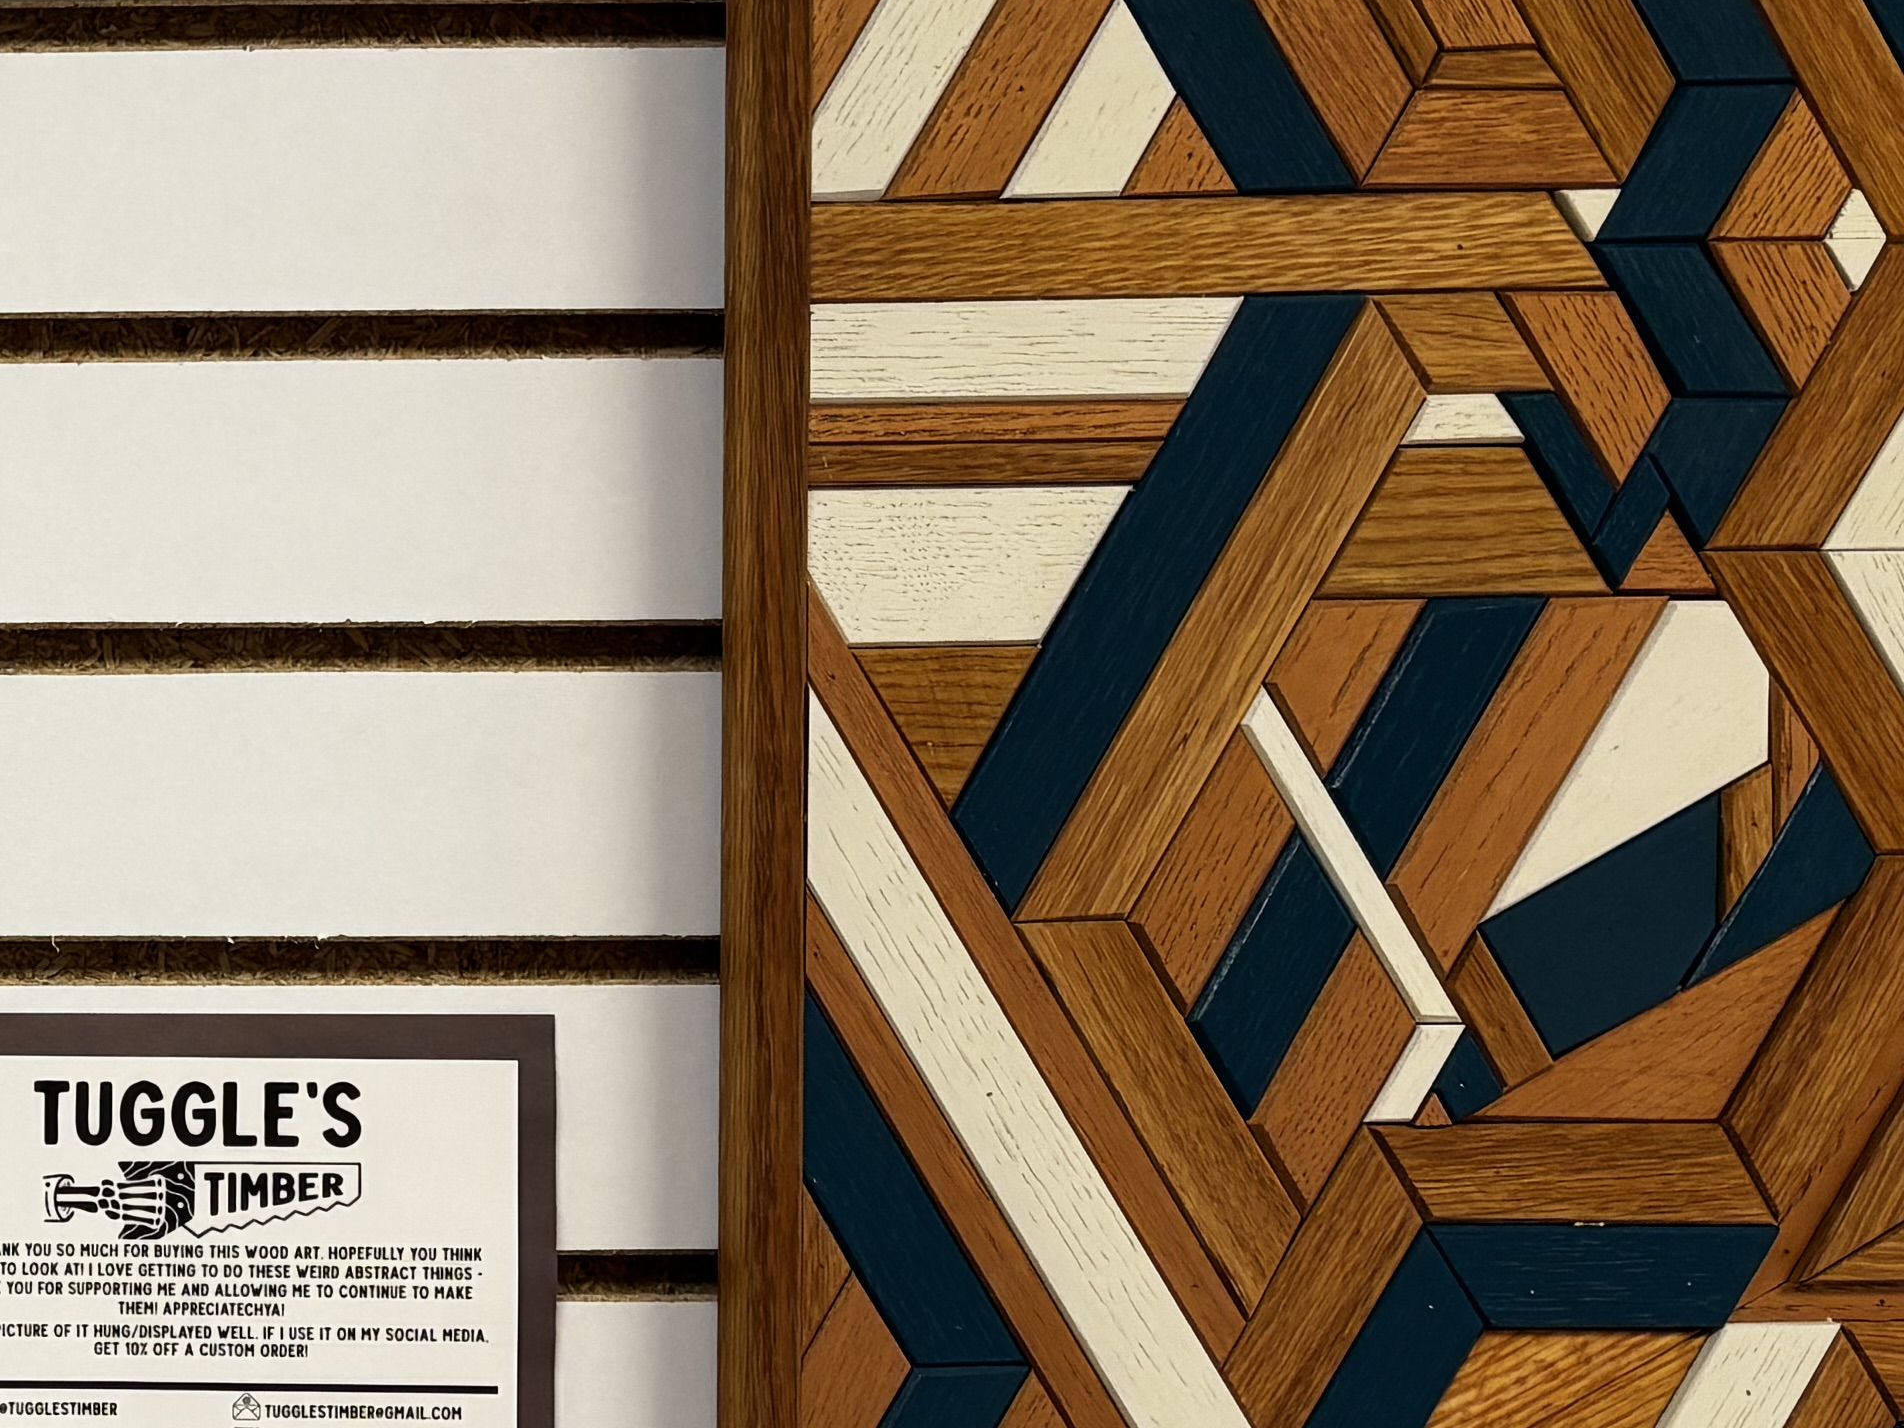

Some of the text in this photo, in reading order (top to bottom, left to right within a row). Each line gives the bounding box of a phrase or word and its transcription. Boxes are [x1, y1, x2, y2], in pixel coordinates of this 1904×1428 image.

[34, 1080, 361, 1148] TUGGLE'S
[204, 1172, 343, 1216] TIMBER
[25, 1242, 51, 1256] YOU
[56, 1242, 75, 1256] SO
[80, 1243, 118, 1257] MUCH
[124, 1243, 149, 1257] FOR
[154, 1243, 203, 1258] BUYING
[209, 1244, 239, 1258] THIS
[245, 1244, 288, 1259] WOOD
[294, 1245, 323, 1259] ART.
[328, 1246, 404, 1260] HOPEFULLY
[410, 1247, 436, 1261] YOU
[442, 1247, 482, 1261] THINK
[0, 1261, 16, 1275] TO
[22, 1261, 58, 1276] LOOK
[89, 1262, 92, 1276] I
[98, 1262, 133, 1276] LOVE
[138, 1262, 196, 1277] GETTING
[201, 1263, 218, 1277] TO
[224, 1263, 243, 1278] DO
[248, 1264, 291, 1278] THESE
[296, 1264, 339, 1279] WEIRD
[345, 1265, 416, 1280] ABSTRACT
[422, 1266, 472, 1280] THINGS
[7, 1280, 32, 1294] YOU
[38, 1280, 63, 1295] FOR
[68, 1281, 152, 1295] SUPPORTING
[157, 1282, 176, 1296] ME
[181, 1282, 209, 1296] AND
[215, 1283, 287, 1297] ALLOWING
[292, 1283, 310, 1298] ME
[316, 1283, 333, 1298] TO
[339, 1284, 406, 1299] CONTINUE
[412, 1285, 429, 1299] TO
[435, 1285, 473, 1299] MAKE
[118, 1300, 158, 1315] THEM!
[54, 1323, 72, 1337] OF
[77, 1323, 89, 1337] IT
[94, 1323, 212, 1339] HUNG/DISPLAYED
[263, 1325, 275, 1340] IF
[280, 1326, 283, 1340] I
[289, 1326, 314, 1340] USE
[320, 1326, 331, 1340] IT
[337, 1326, 356, 1341] ON
[361, 1327, 380, 1341] MY
[386, 1327, 437, 1342] SOCIAL
[94, 1341, 308, 1357] GET 10% OFF A CUSTOM ORDER!
[0, 1401, 117, 1416] @TUGGLESTIMBER
[265, 1404, 462, 1420] TUGGLESTIMBER@GMAIL.COM
